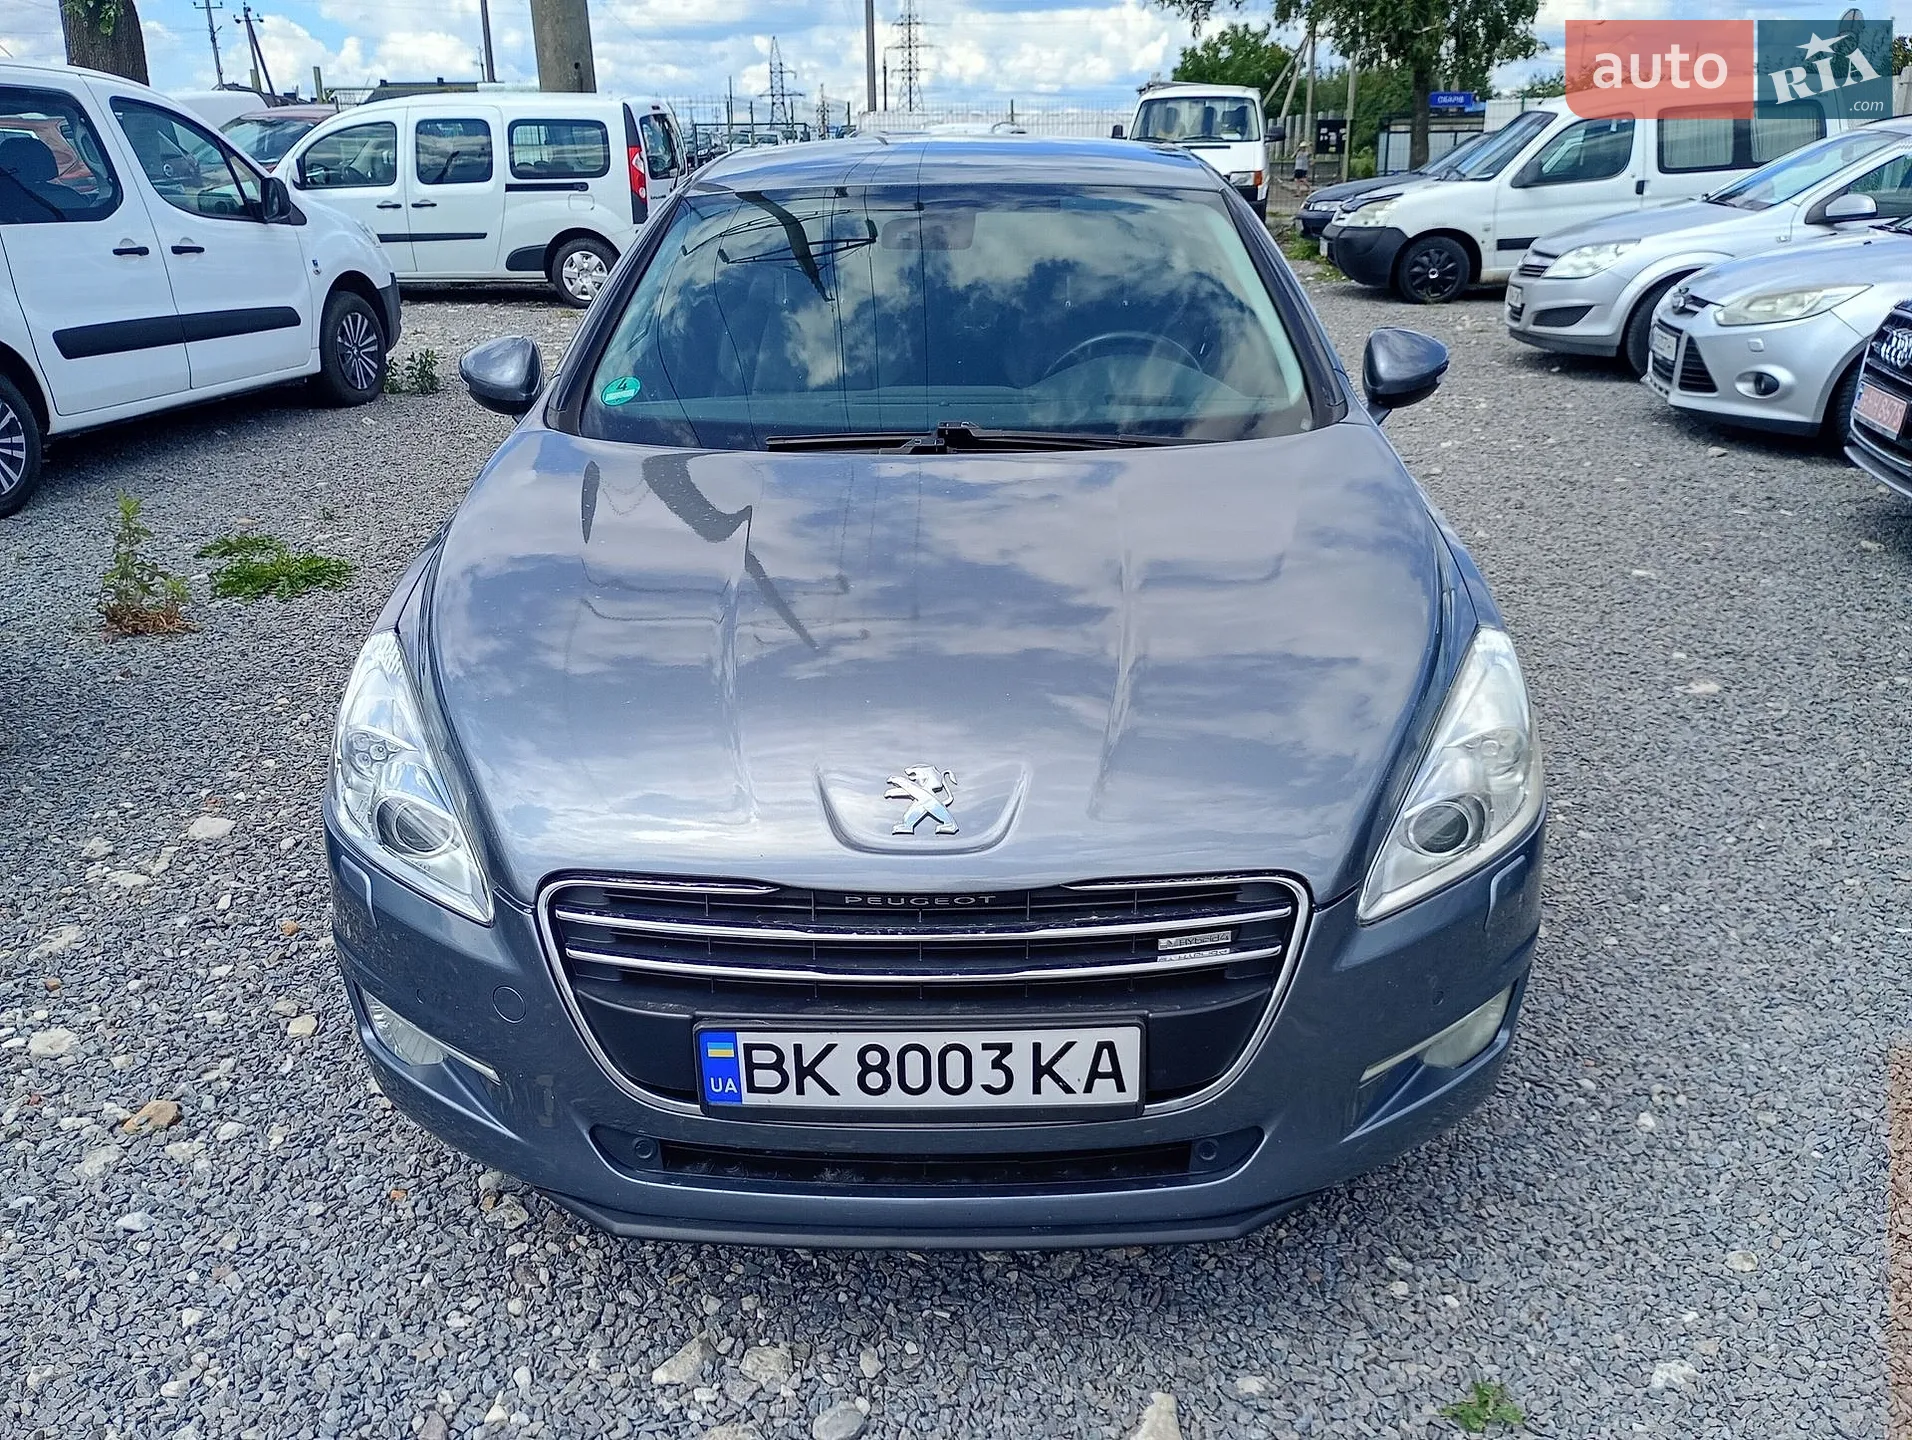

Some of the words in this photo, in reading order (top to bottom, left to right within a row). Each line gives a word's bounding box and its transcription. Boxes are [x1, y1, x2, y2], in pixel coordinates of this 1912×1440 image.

[616, 377, 629, 391] 4
[844, 895, 997, 906] PEUGEOT
[710, 1077, 738, 1093] UA
[743, 1042, 841, 1096] BK
[857, 1042, 1015, 1097] 8003
[1031, 1040, 1127, 1095] KA
